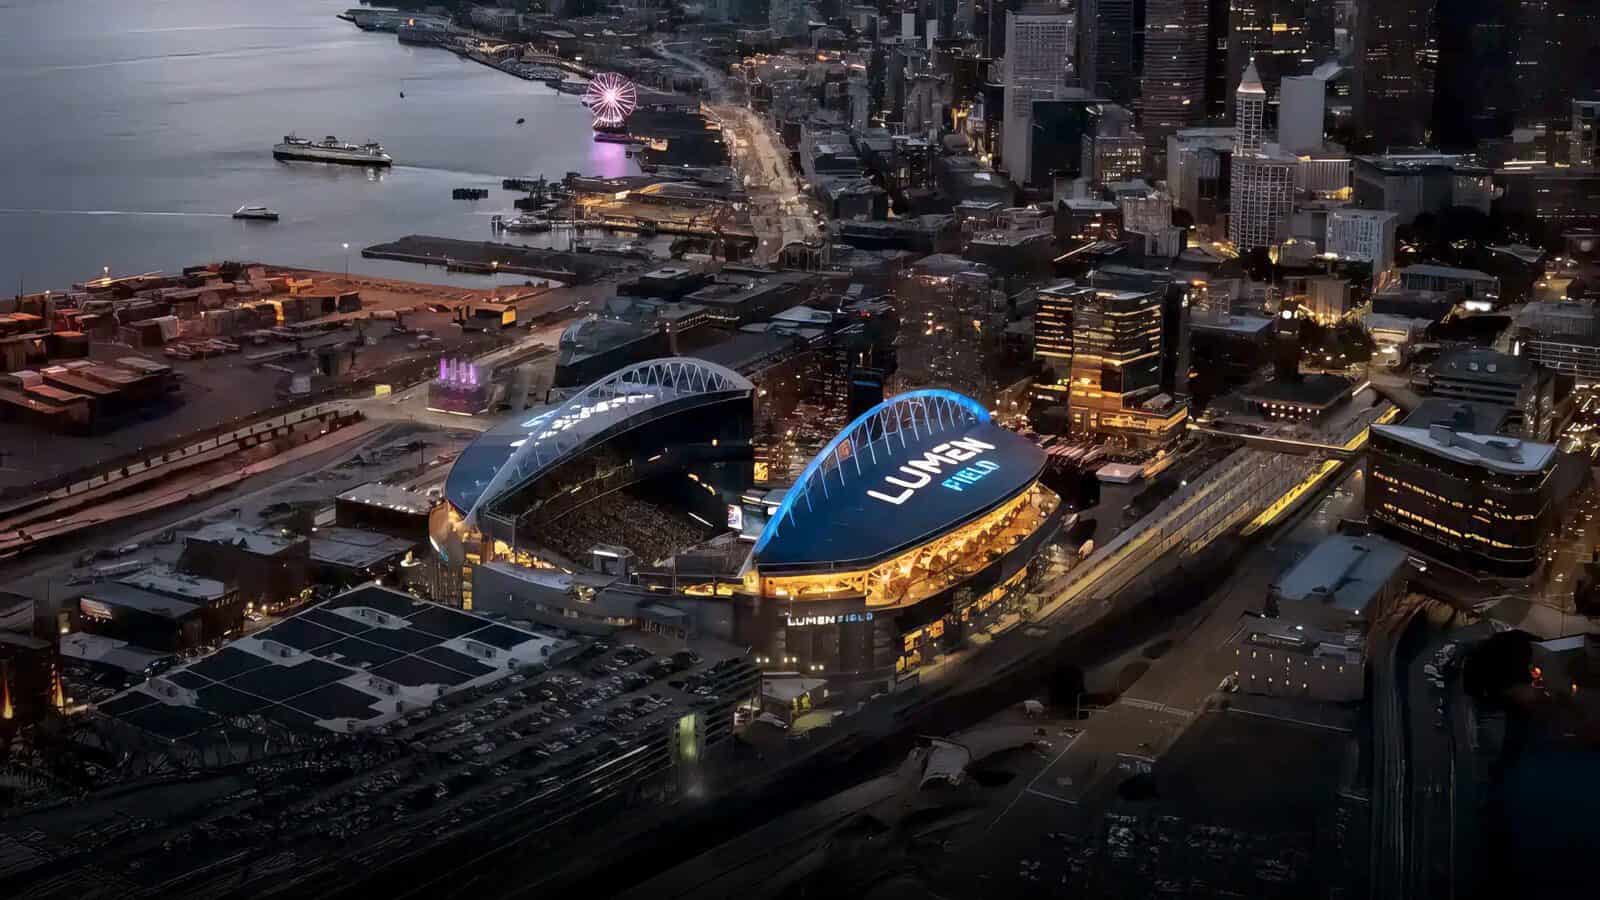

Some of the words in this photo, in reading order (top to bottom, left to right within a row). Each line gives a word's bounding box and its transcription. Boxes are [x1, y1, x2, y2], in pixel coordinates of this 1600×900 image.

[866, 436, 996, 505] LUMEN
[941, 460, 1001, 492] FIELD
[787, 615, 835, 626] LUMEN
